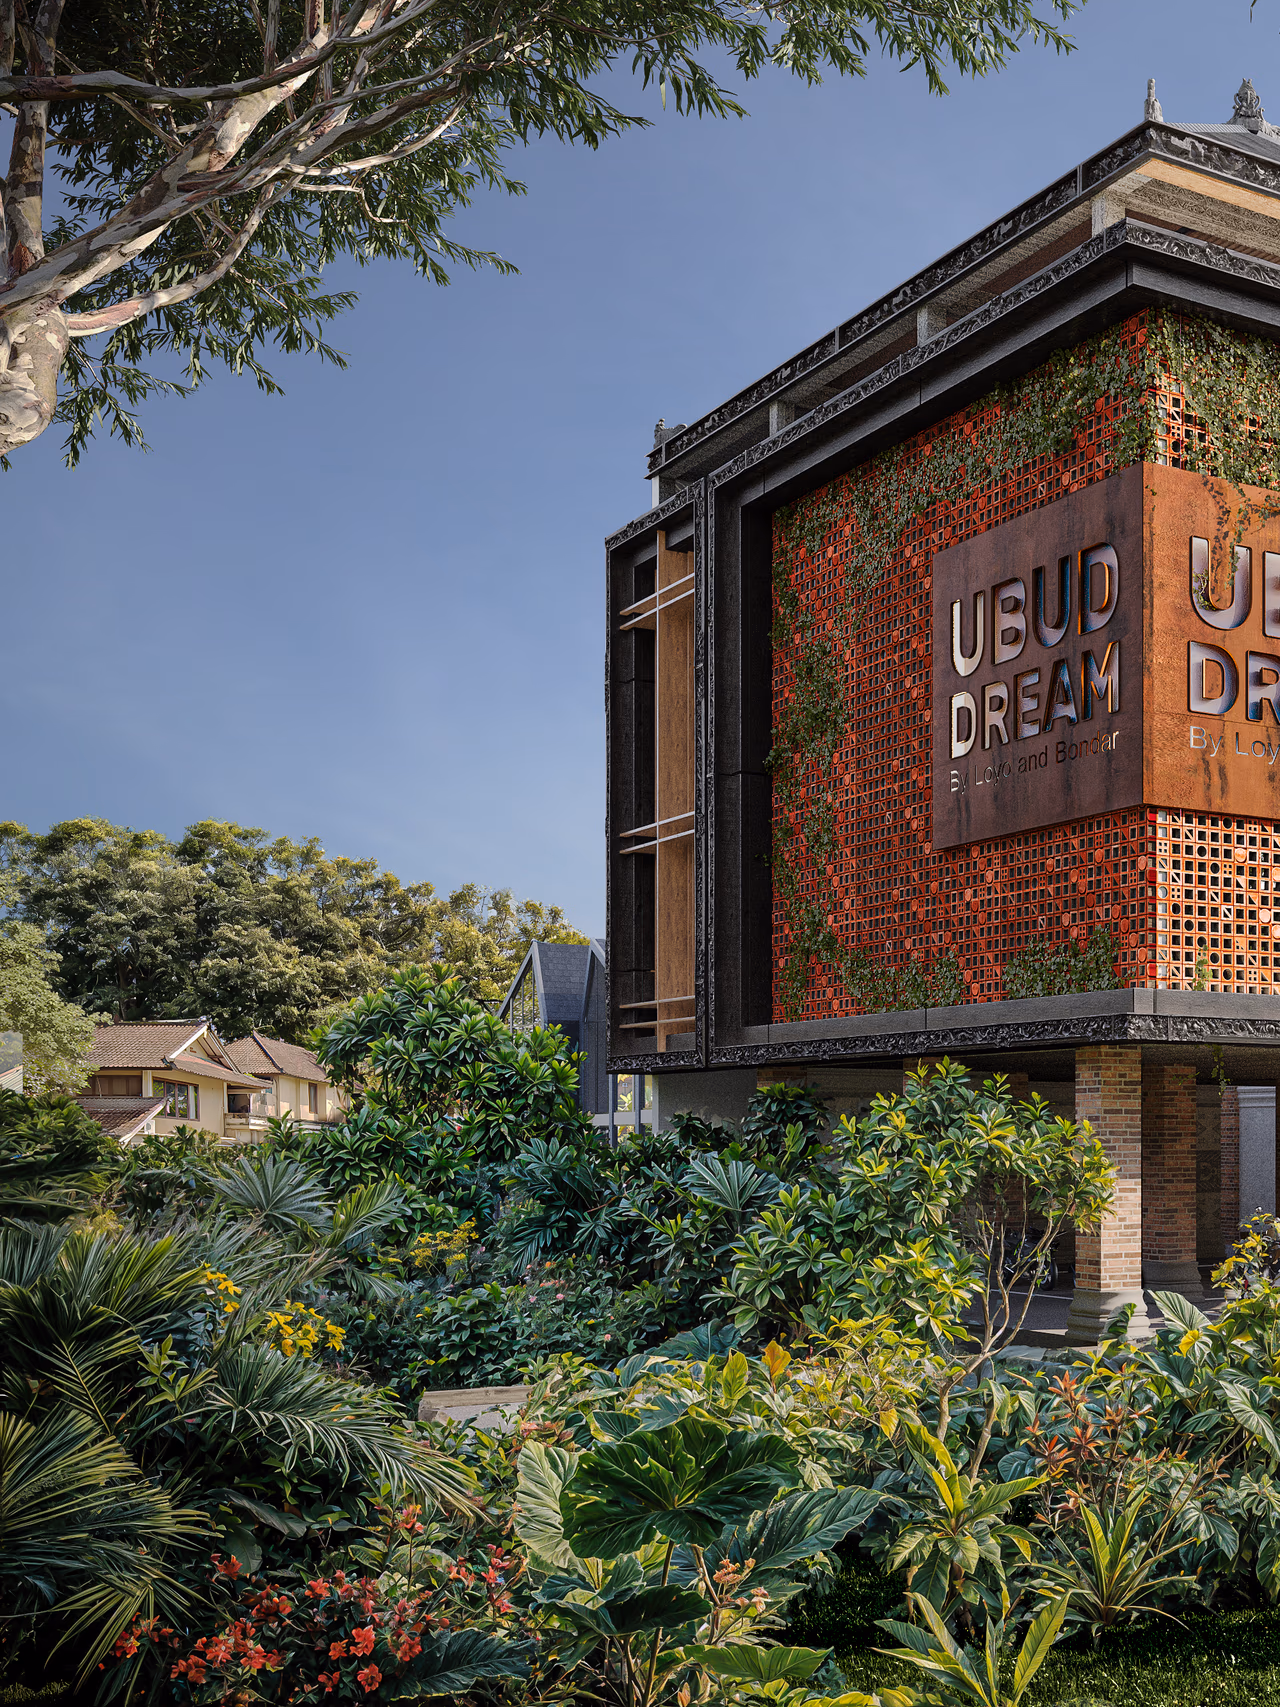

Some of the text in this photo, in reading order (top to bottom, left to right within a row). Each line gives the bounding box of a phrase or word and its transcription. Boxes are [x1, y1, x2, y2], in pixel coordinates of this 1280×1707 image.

[950, 541, 1120, 677] UBUD
[949, 641, 1120, 759] DREAM
[1189, 725, 1222, 757] By
[950, 730, 1120, 794] By Loyo and Bondar
